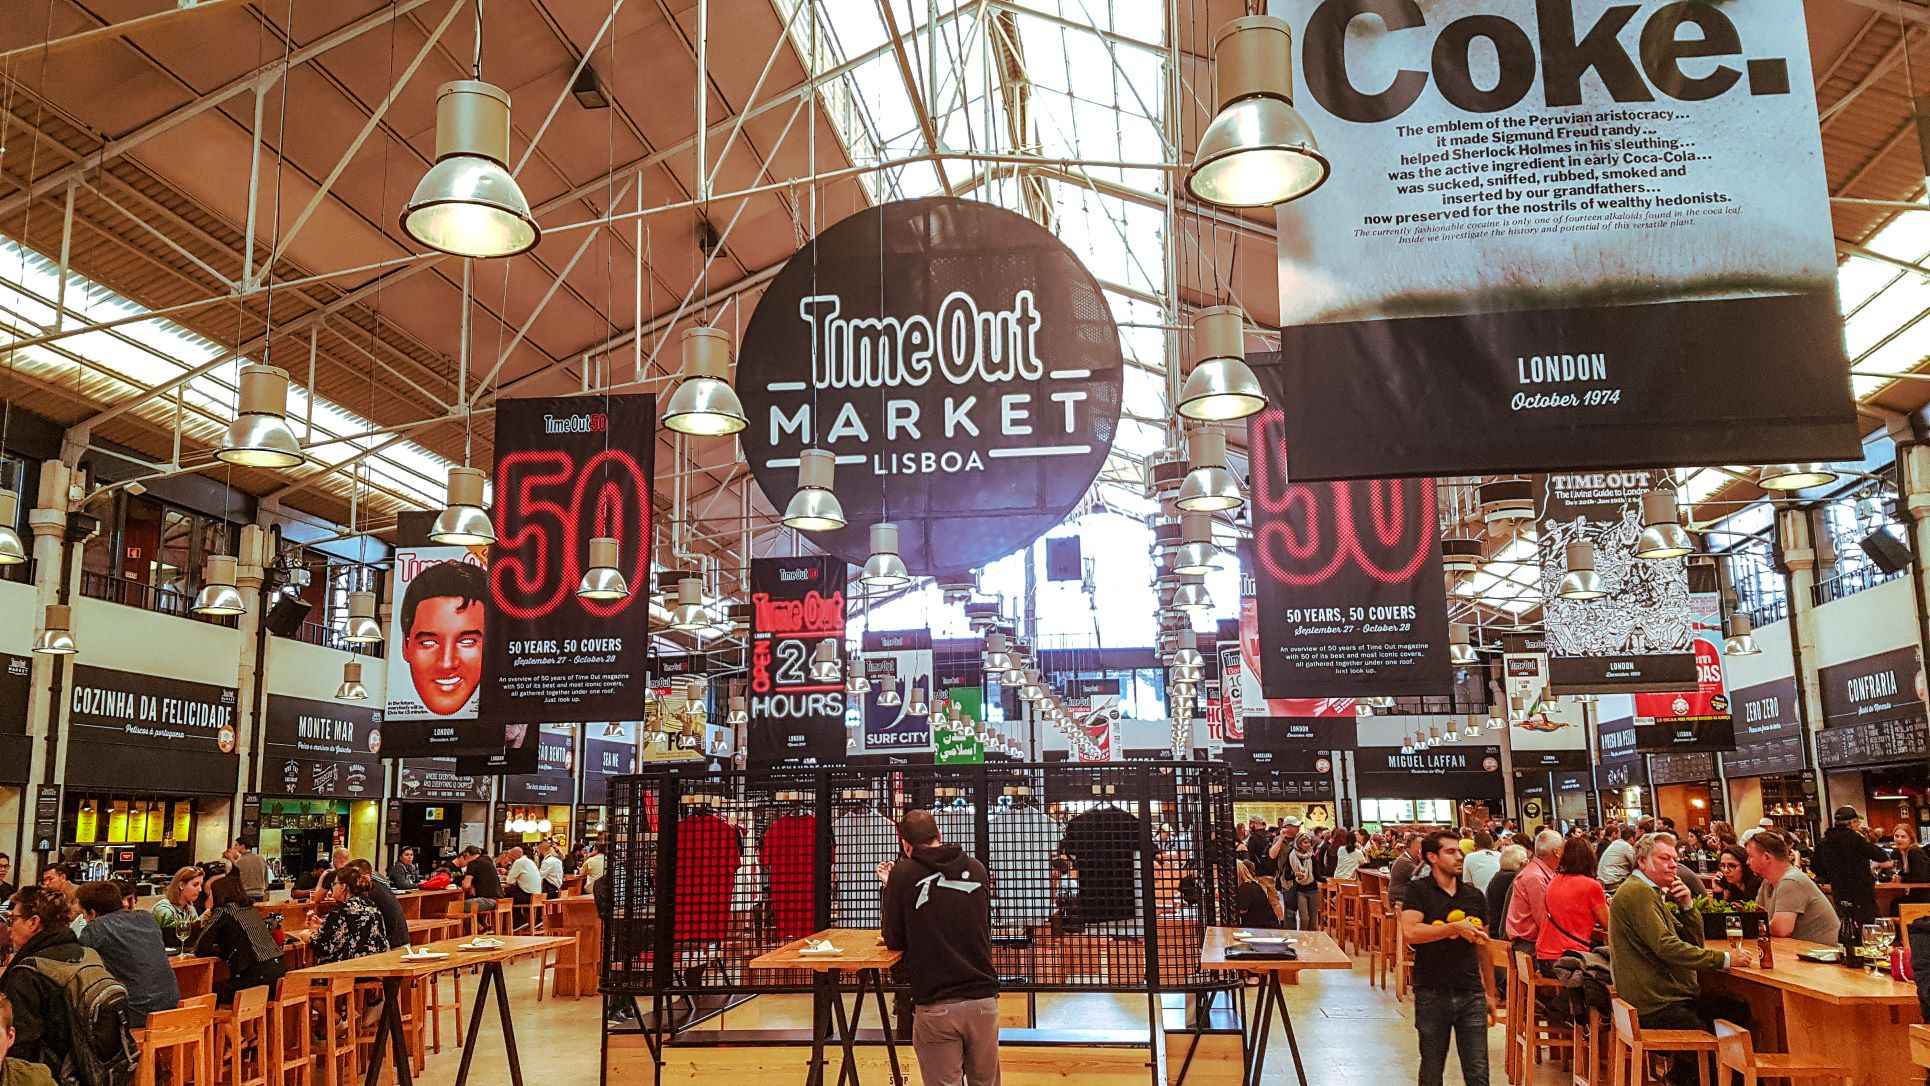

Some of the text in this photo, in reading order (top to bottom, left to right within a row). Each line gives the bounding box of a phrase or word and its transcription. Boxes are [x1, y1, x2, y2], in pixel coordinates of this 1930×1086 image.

[1302, 0, 1790, 122] Coke.
[1396, 126, 1423, 137] The
[1427, 120, 1483, 133] emblem
[1486, 117, 1500, 129] of
[1503, 116, 1525, 128] the
[1529, 113, 1592, 127] Peruvian
[1436, 136, 1446, 147] it
[1450, 131, 1488, 146] made
[1492, 128, 1554, 144] Sigmund
[1557, 125, 1598, 139] Freud
[1401, 150, 1449, 166] helped
[1452, 145, 1515, 161] Sherlock
[1519, 142, 1571, 155] Holmes
[1575, 140, 1588, 151] in
[1591, 139, 1611, 151] his
[1388, 170, 1415, 181] was
[1418, 166, 1442, 178] the
[1445, 162, 1489, 176] active
[1492, 157, 1564, 173] ingredient
[1568, 155, 1581, 167] in
[1584, 153, 1619, 167] early
[1397, 165, 1686, 195] was sucked, sniffed, rubbed, smoked and
[1364, 191, 1731, 226] now preserved for the nostrils of wealthy hedonists.
[1442, 188, 1501, 205] inserted
[1505, 188, 1522, 201] by
[1526, 187, 1549, 198] our
[1353, 228, 1370, 238] The
[1372, 226, 1411, 237] currently
[1413, 223, 1464, 236] fashionable
[1467, 220, 1500, 230] cocaine
[1503, 219, 1510, 227] is
[1512, 218, 1532, 227] only
[1535, 217, 1549, 225] one
[1552, 215, 1563, 225] of
[1565, 213, 1602, 223] fourteen
[1604, 211, 1643, 221] alkaloids
[1646, 210, 1671, 221] found
[1686, 207, 1700, 216] the
[1703, 207, 1722, 216] coca
[1399, 235, 1424, 244] Inside
[1441, 230, 1488, 241] investigate
[1491, 228, 1505, 237] the
[1507, 226, 1539, 237] history
[1541, 225, 1558, 233] and
[1560, 223, 1599, 234] potential
[1602, 221, 1612, 231] of
[1614, 221, 1630, 230] this
[1633, 220, 1667, 229] versatile
[1517, 353, 1607, 384] LONDON
[1511, 389, 1621, 411] October 1974
[769, 392, 1087, 446] MARKET
[873, 450, 985, 475] LISBOA
[489, 449, 650, 619] 50
[1286, 605, 1417, 624] 50 YEARS, 50 COVERS
[1295, 623, 1411, 637] September 27 October 28
[509, 638, 622, 655] 50 YEARS, 50 COVERS
[513, 656, 555, 667] September
[573, 655, 604, 664] October
[1610, 661, 1635, 671] LONDON
[1848, 670, 1898, 703] CONFRARIA
[73, 686, 232, 728] COZINHA DA FELICIDADE
[752, 693, 844, 719] HOURS
[1745, 699, 1762, 722] ZERO
[1762, 696, 1779, 720] ZERO
[298, 715, 354, 742] MONTE MAR
[866, 731, 929, 745] SURF CITY
[1388, 754, 1466, 768] MIGUEL LAFFAN
[889, 1076, 909, 1085] SP
